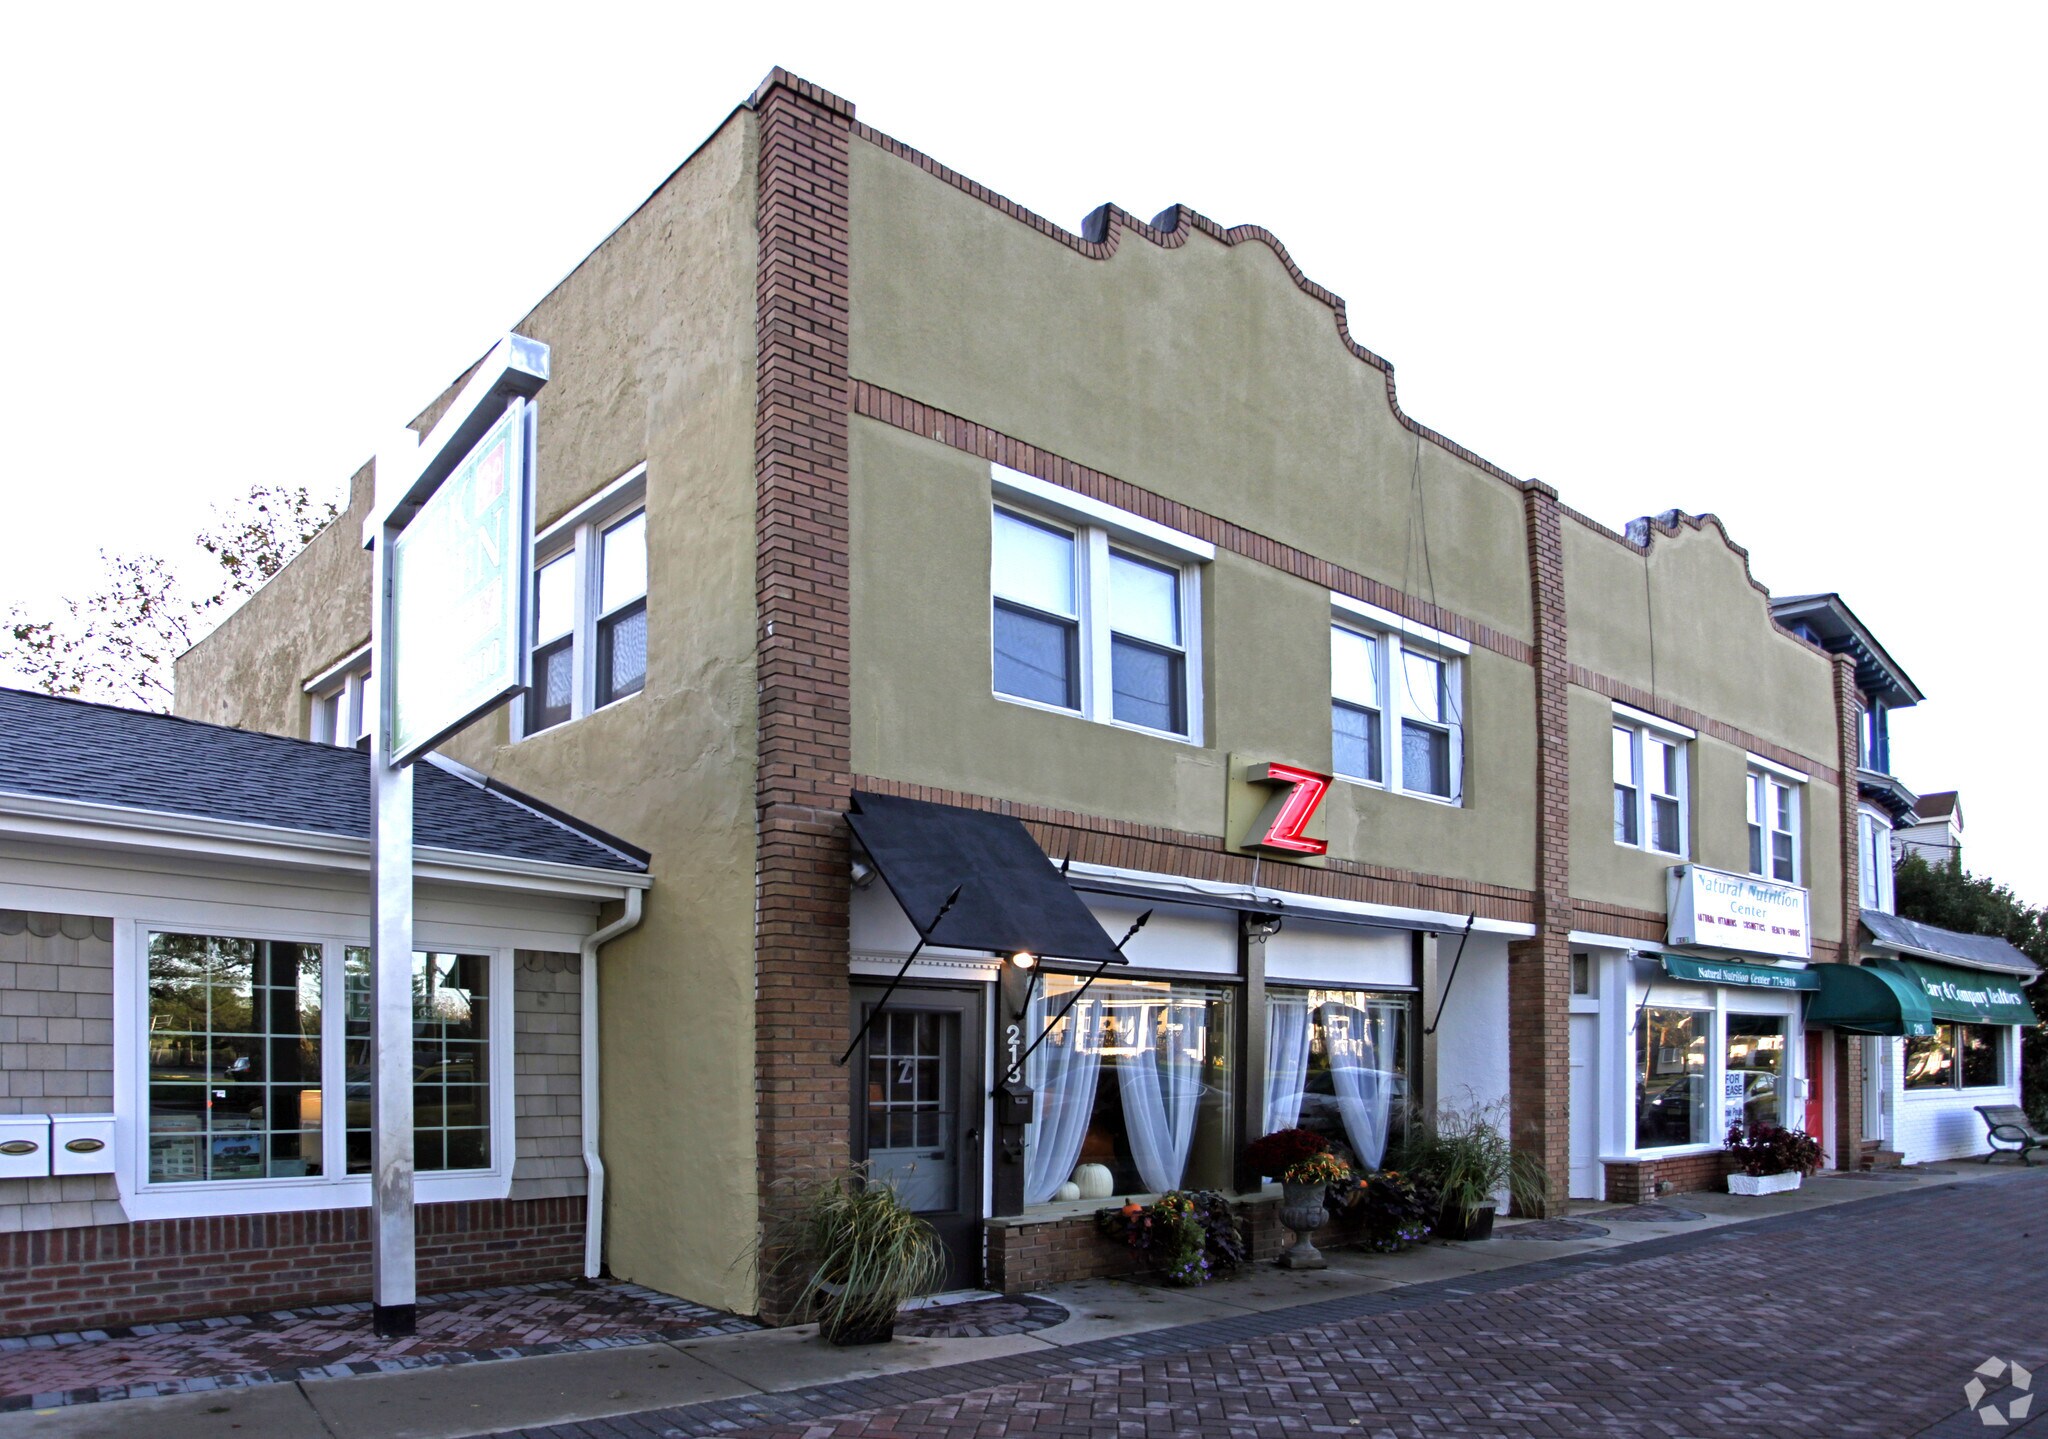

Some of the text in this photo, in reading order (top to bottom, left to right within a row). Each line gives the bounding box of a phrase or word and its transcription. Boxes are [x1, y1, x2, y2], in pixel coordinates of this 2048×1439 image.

[1261, 762, 1334, 855] Z
[1699, 874, 1798, 908] Natural Nutrition
[1731, 901, 1766, 918] Center
[1698, 967, 1722, 979] Natural
[1723, 970, 1749, 983] Nutrition
[1751, 973, 1771, 985] Center
[1942, 981, 1953, 999] &
[1949, 983, 1989, 1008] Company
[1986, 987, 2022, 1005] Realtors
[898, 1060, 913, 1084] Z
[1725, 1073, 1740, 1084] FOR
[1725, 1085, 1743, 1096] EASE
